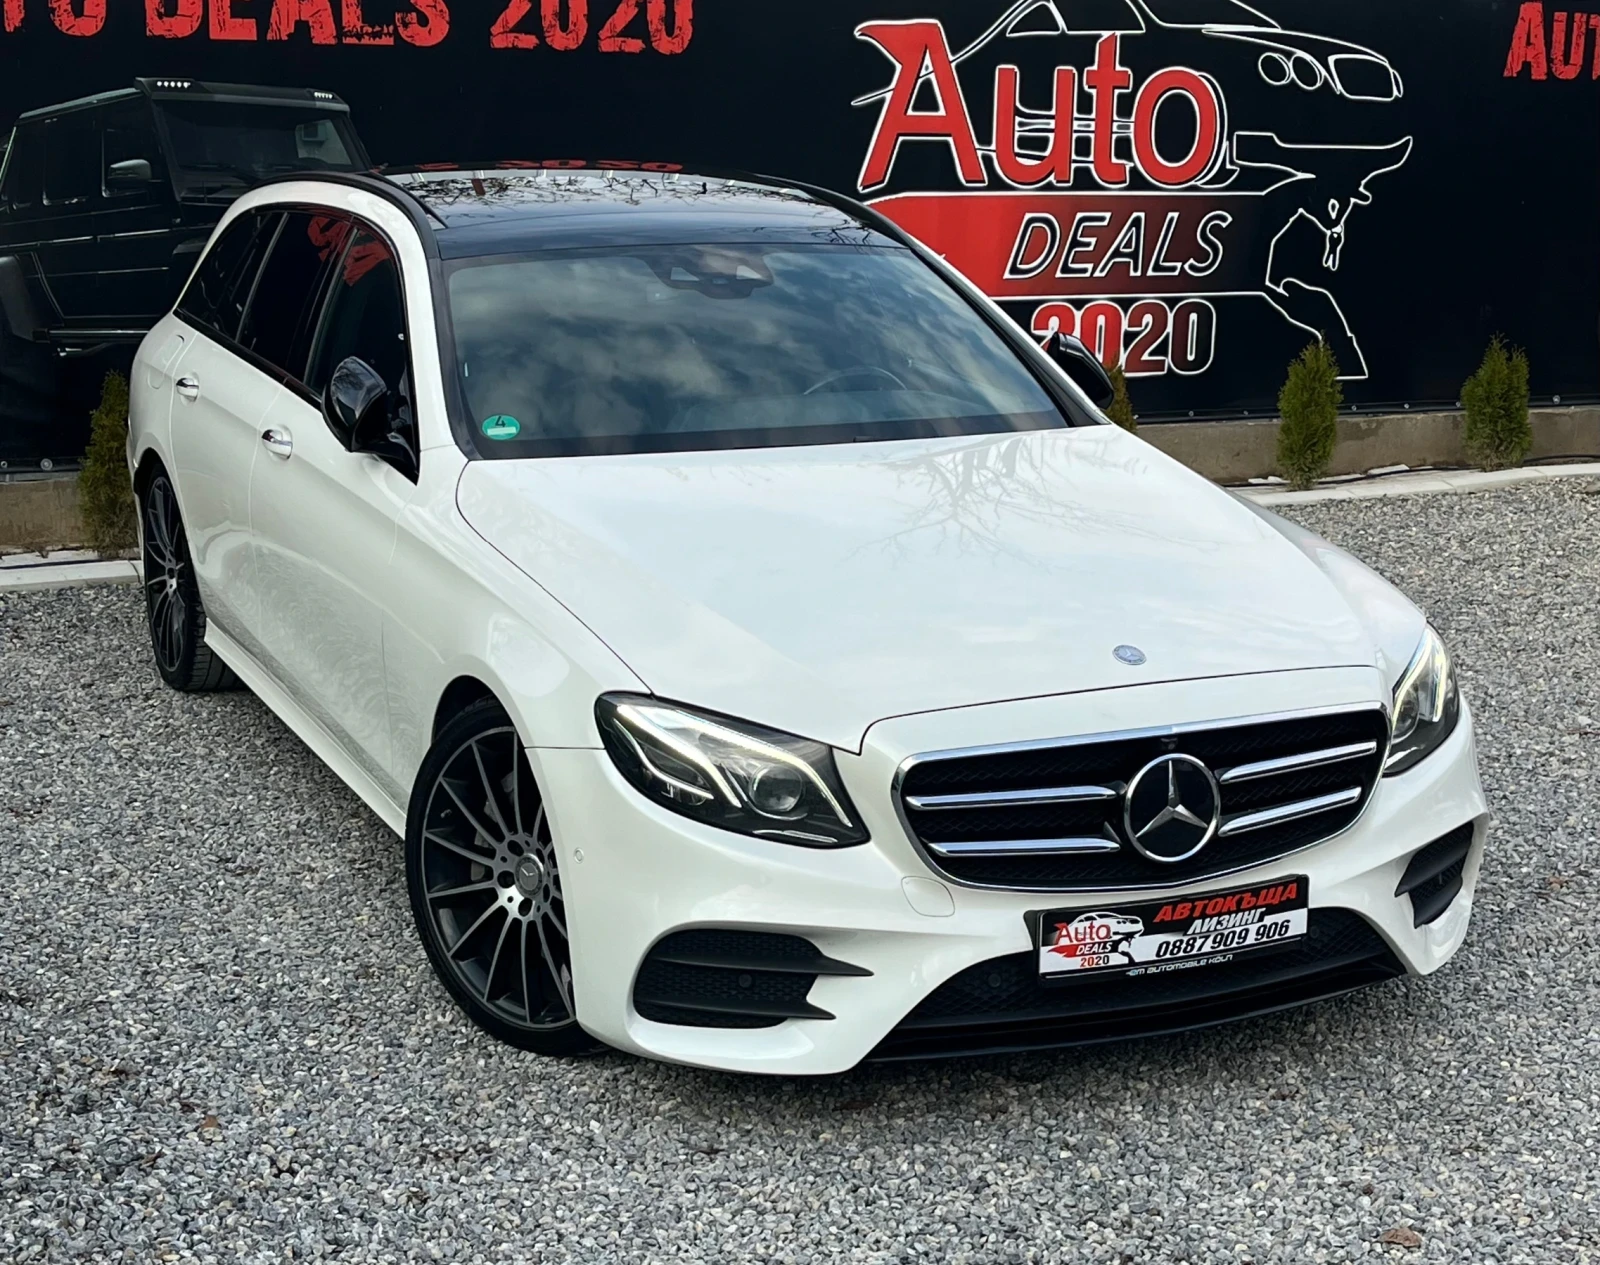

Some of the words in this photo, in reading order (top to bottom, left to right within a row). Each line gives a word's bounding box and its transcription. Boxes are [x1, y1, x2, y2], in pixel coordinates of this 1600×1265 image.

[854, 19, 1222, 190] Auto
[1003, 210, 1233, 279] DEALS
[495, 415, 506, 428] 4
[1153, 883, 1297, 922] АВТОКЪЩА
[1053, 920, 1112, 946] Auto
[1186, 907, 1266, 935] ЛИЗИНГ
[1075, 941, 1113, 956] DEALS
[1155, 934, 1212, 959] 0887
[1210, 927, 1250, 950] 909
[1254, 919, 1291, 942] 906
[1080, 954, 1110, 967] 2020
